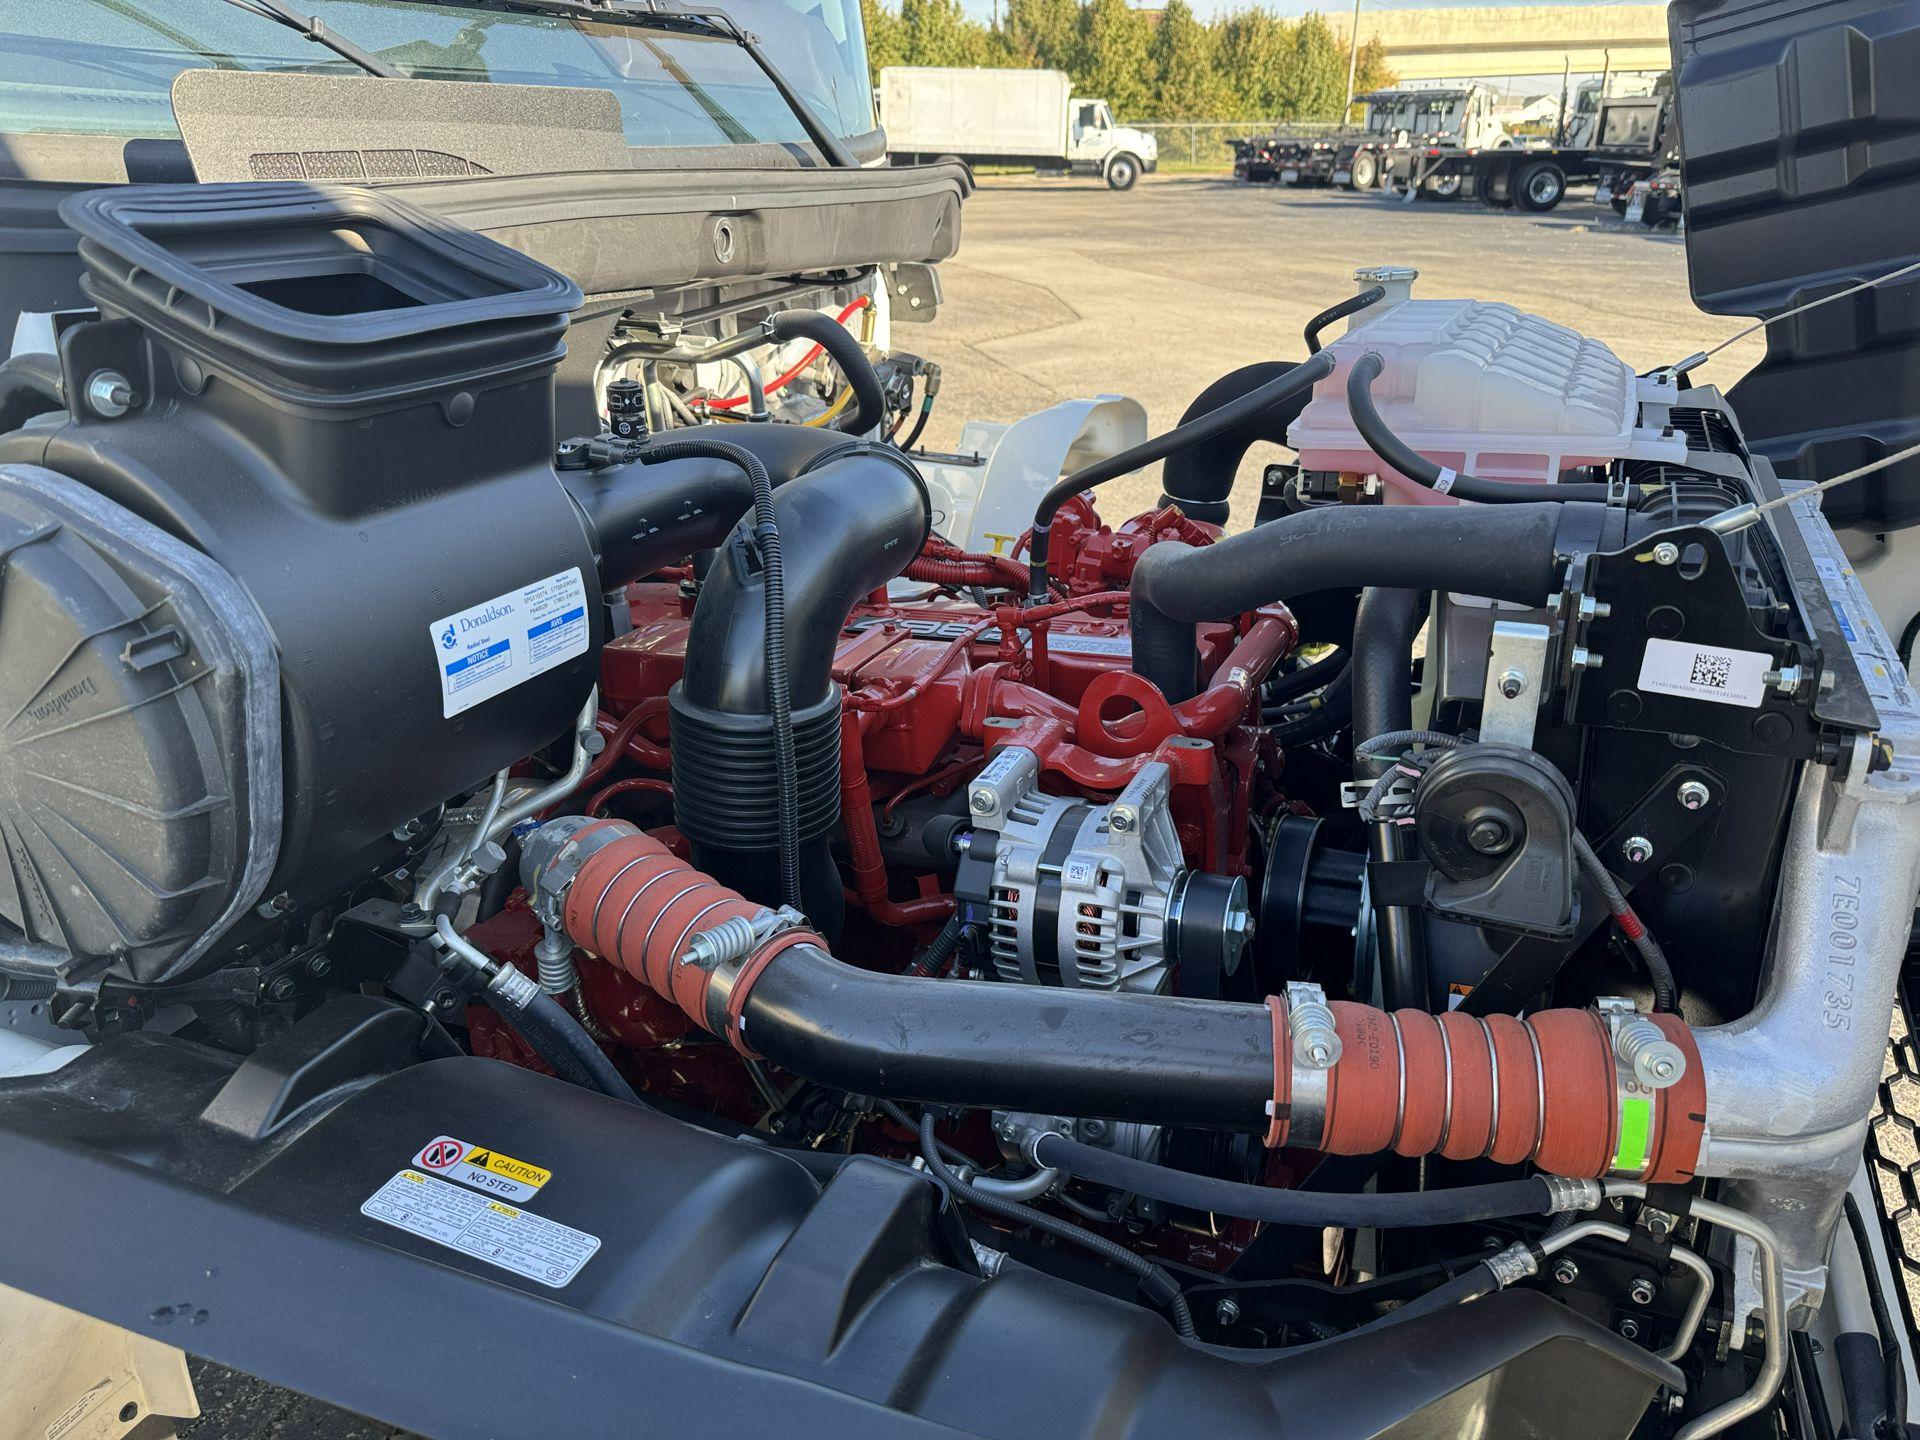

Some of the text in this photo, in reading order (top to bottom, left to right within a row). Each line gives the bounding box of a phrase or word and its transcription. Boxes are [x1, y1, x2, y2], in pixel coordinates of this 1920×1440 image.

[460, 604, 514, 632] Donaldson
[467, 650, 489, 665] NOTICE
[1822, 875, 1861, 1030] 7E001735
[494, 1159, 545, 1182] CAUTION
[467, 1171, 518, 1194] NO STEP
